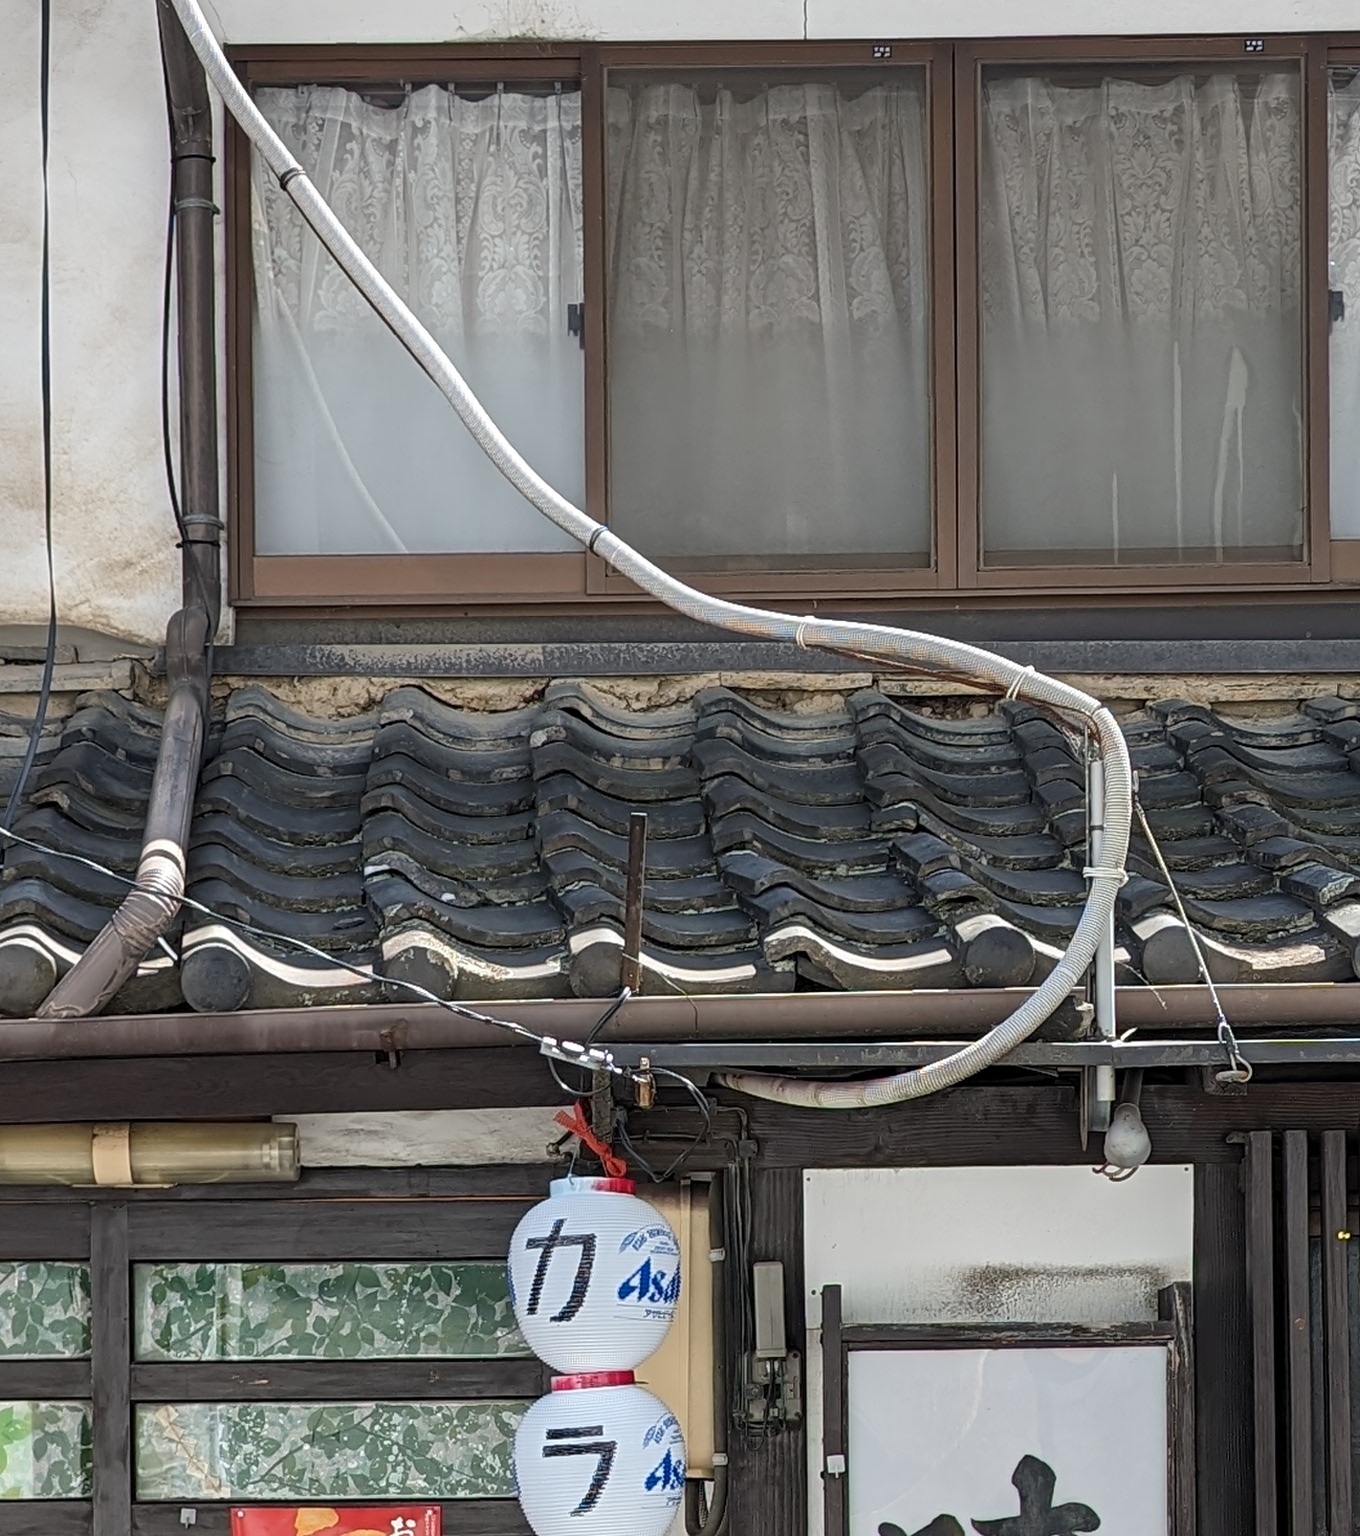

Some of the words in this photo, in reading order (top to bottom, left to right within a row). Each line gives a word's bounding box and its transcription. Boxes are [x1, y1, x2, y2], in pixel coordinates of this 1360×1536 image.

[525, 1218, 597, 1322] カ
[618, 1256, 681, 1304] Asa
[542, 1425, 618, 1516] ラ
